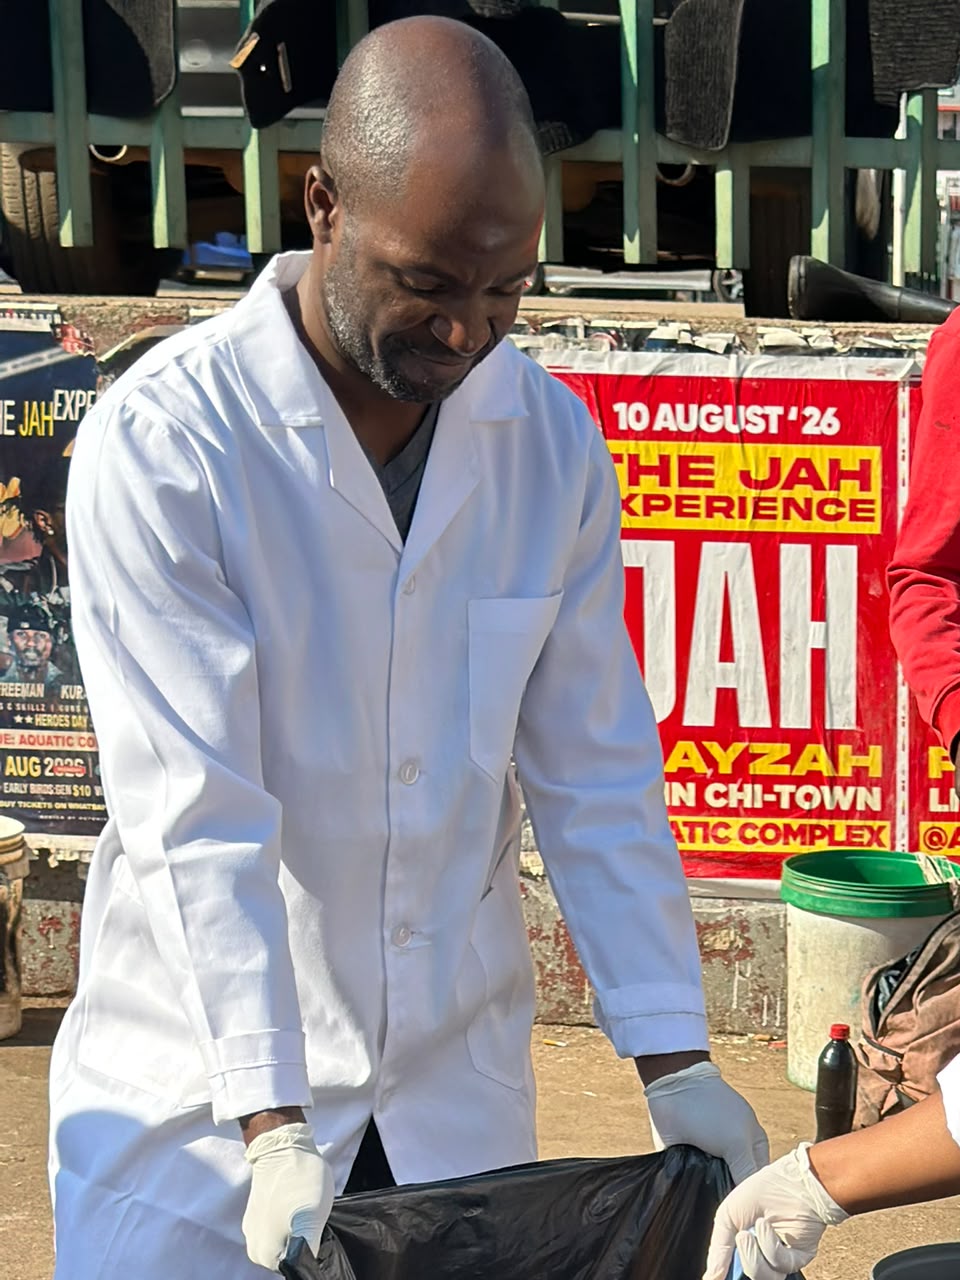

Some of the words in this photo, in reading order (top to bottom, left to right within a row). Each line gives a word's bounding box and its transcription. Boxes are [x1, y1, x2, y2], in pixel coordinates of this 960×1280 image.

[19, 400, 54, 437] JAH
[612, 402, 649, 431] 10
[652, 403, 785, 434] AUGUST
[611, 453, 714, 489] HE
[738, 457, 872, 492] JAH
[620, 539, 859, 730] JAH
[34, 714, 70, 727] HEROES
[19, 735, 75, 748] AQUATIC
[79, 737, 96, 748] CO
[4, 756, 41, 778] AUG
[3, 783, 28, 794] EARLY
[664, 782, 696, 807] IN
[704, 783, 882, 812] CHI-TOWN
[737, 823, 888, 848] COMPLEX
